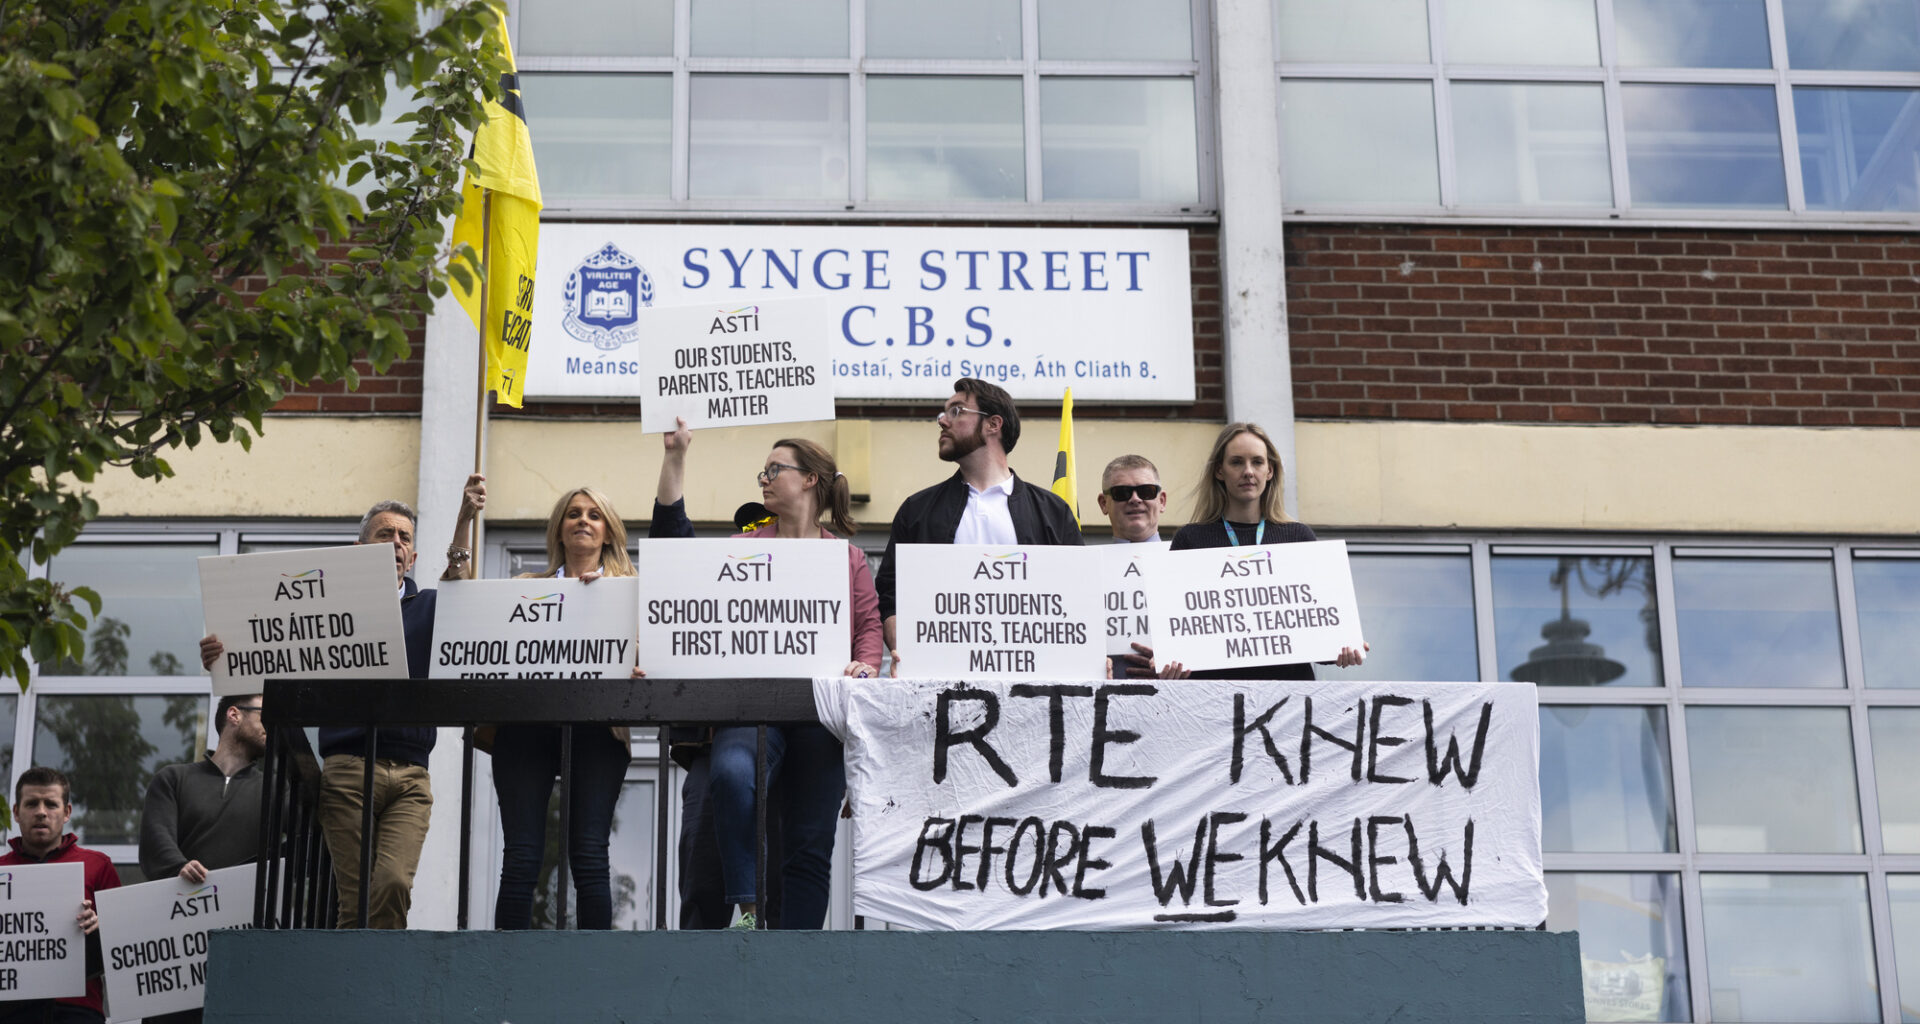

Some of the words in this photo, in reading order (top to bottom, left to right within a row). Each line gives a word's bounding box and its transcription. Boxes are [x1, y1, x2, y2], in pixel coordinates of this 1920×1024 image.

[586, 272, 632, 280] VIRILITER
[682, 248, 891, 290] SYNGE
[919, 249, 1150, 292] STREET
[599, 281, 619, 289] AGE
[709, 314, 760, 336] ASTI
[840, 305, 1012, 348] C.B.S.
[566, 353, 639, 375] Meánsc
[832, 357, 892, 379] iostaí,
[901, 356, 951, 377] Sráid
[960, 359, 1025, 381] Synge,
[1034, 354, 1066, 377] Áth
[1075, 360, 1132, 377] Cliath
[1139, 361, 1157, 379] 8.
[675, 347, 708, 369] OUR
[711, 341, 797, 369] STUDENTS,
[658, 371, 734, 397] PARENTS,
[736, 365, 816, 391] TEACHERS
[708, 394, 768, 419] MATTER
[717, 562, 772, 582] ASTI
[974, 560, 1027, 580] ASTI
[1220, 558, 1273, 578] ASTI
[274, 578, 325, 601] ASTI
[1184, 590, 1221, 611] OUR
[1223, 583, 1318, 609] STUDENTS,
[509, 602, 563, 623] ASTI
[648, 599, 722, 625] SCHOOL
[727, 598, 841, 624] COMMUNITY
[935, 592, 970, 615] OUR
[975, 592, 1068, 618] STUDENTS,
[289, 612, 326, 641] ÁITE
[328, 612, 355, 638] DO
[916, 621, 998, 645] PARENTS,
[1001, 621, 1087, 645] TEACHERS
[1169, 612, 1251, 637] PARENTS,
[1253, 606, 1340, 631] TEACHERS
[439, 640, 510, 666] SCHOOL
[515, 639, 628, 665] COMMUNITY
[672, 630, 727, 657] FIRST,
[731, 630, 769, 655] NOT
[774, 631, 818, 655] LAST
[1225, 634, 1292, 659] MATTER
[227, 648, 296, 677] PHOBAL
[300, 646, 326, 672] NA
[329, 641, 390, 670] SCOILE
[969, 649, 1035, 672] MATTER
[932, 684, 1160, 788] RTE
[909, 815, 1116, 899] BEFORE
[1142, 812, 1248, 906] WE
[170, 893, 219, 920] ASTI
[0, 938, 67, 962] EACHERS
[110, 936, 181, 971] SCHOOL
[136, 965, 188, 996] FIRST,
